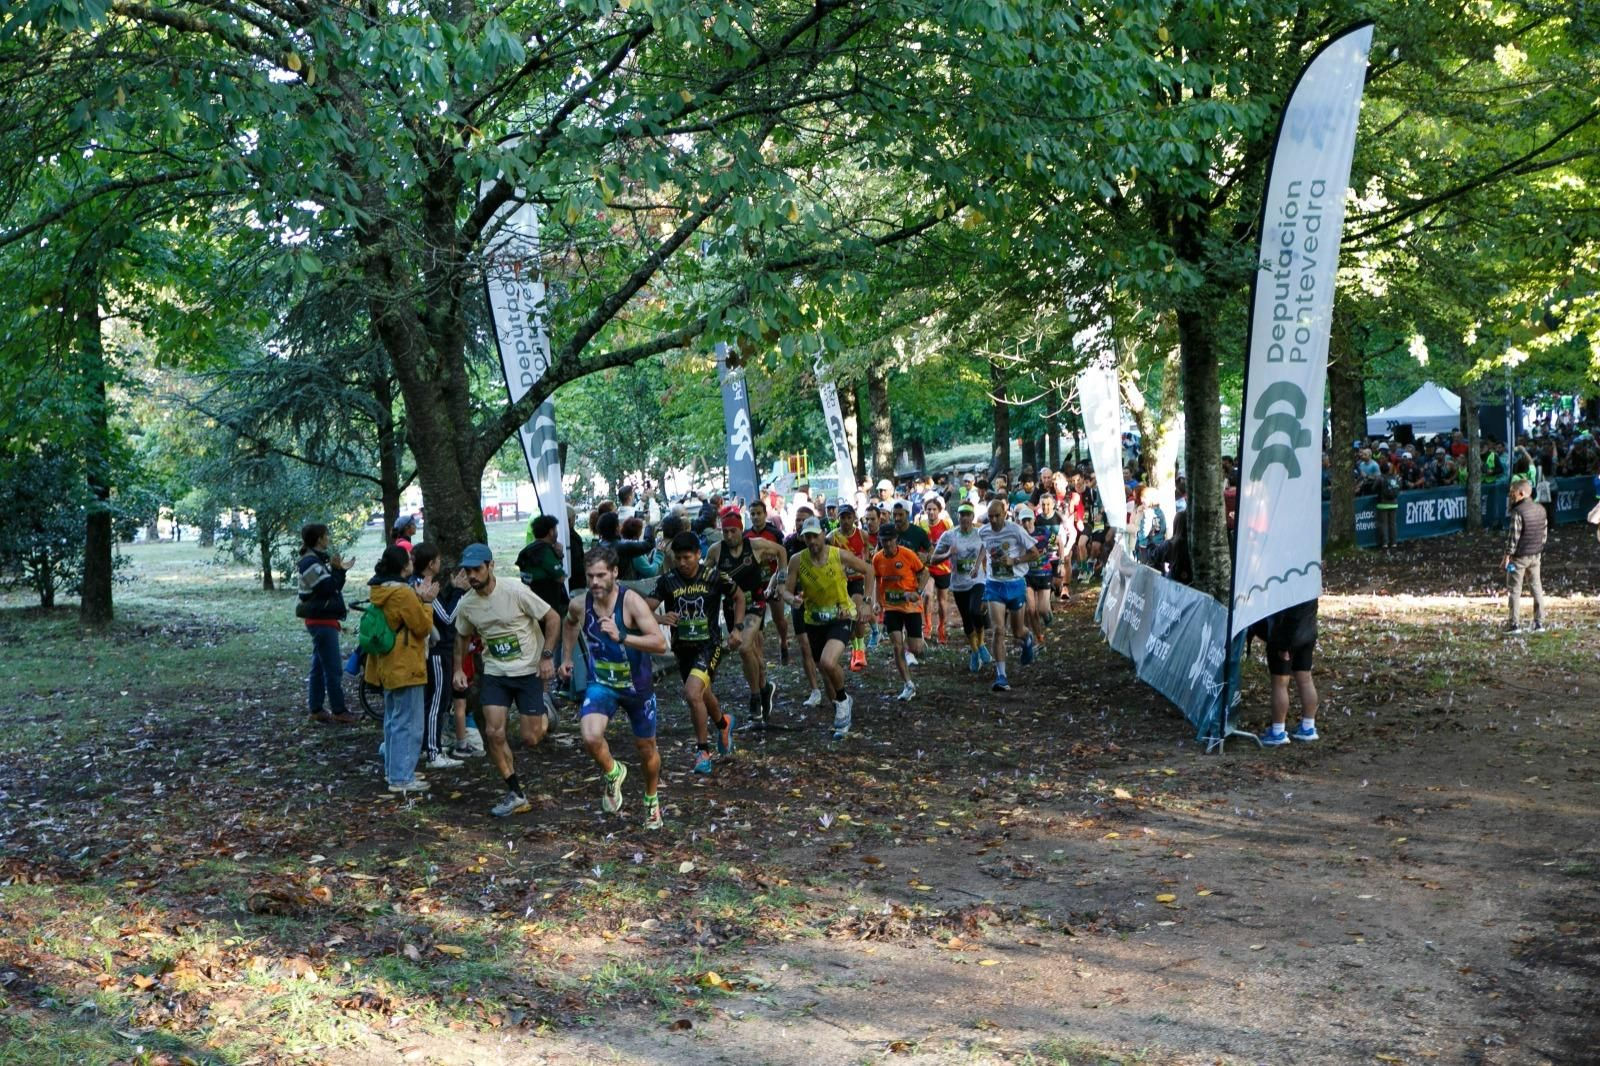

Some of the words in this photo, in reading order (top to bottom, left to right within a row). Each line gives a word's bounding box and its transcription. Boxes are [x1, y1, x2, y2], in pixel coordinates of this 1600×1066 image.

[1266, 180, 1303, 363] Deputación
[1289, 179, 1326, 363] Pontevedra
[1405, 499, 1436, 524] ENTRE
[495, 643, 511, 652] 145
